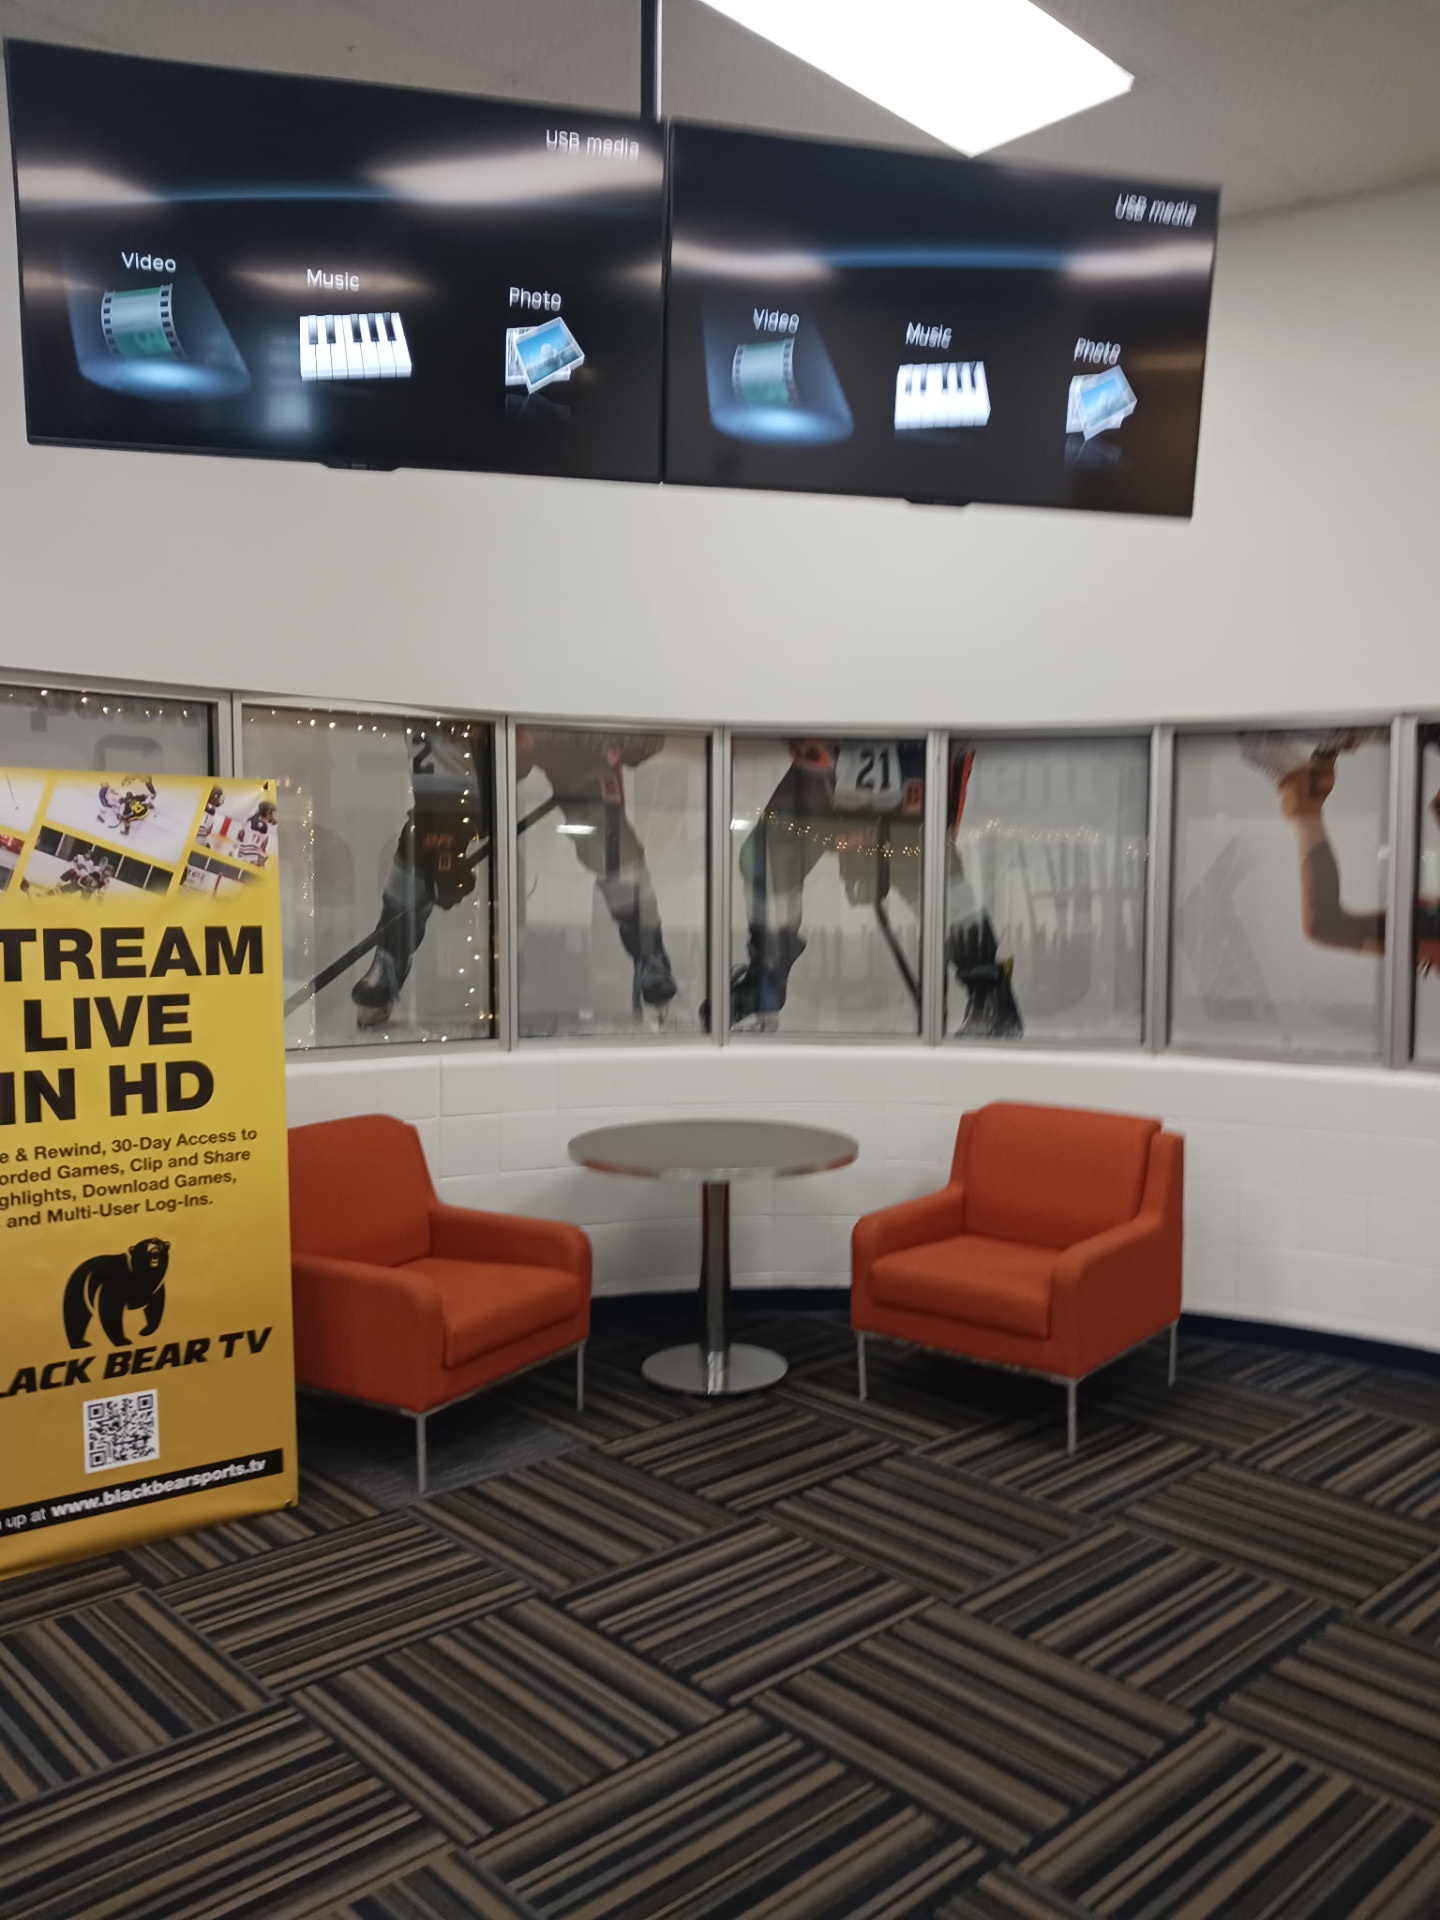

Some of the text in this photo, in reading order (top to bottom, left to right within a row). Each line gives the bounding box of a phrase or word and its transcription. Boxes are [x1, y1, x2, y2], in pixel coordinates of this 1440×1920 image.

[546, 129, 639, 160] USB media
[1115, 193, 1197, 227] USB media
[121, 251, 176, 273] Video
[306, 268, 360, 291] Music
[509, 286, 561, 311] Photo
[752, 308, 799, 334] Video
[905, 321, 952, 349] Music
[1073, 337, 1121, 365] Photo
[24, 994, 192, 1052] LIVE
[0, 1060, 214, 1126] IN HD
[15, 1147, 28, 1162] &
[34, 1141, 107, 1160] Rewind,
[111, 1136, 171, 1153] 30-Day
[176, 1133, 236, 1147] Access
[241, 1128, 258, 1141] to
[57, 1163, 125, 1179] Games,
[130, 1156, 163, 1173] Clip
[168, 1152, 198, 1168] and
[203, 1150, 251, 1165] Share
[82, 1176, 169, 1198] Download
[174, 1172, 237, 1188] Games,
[6, 1194, 213, 1228] and Multi-User Log-Ins.
[103, 1337, 211, 1379] BEAR
[218, 1326, 273, 1359] TV
[5, 1514, 27, 1528] up
[30, 1507, 46, 1522] at
[50, 1459, 266, 1517] www.blackbearsports.tv
